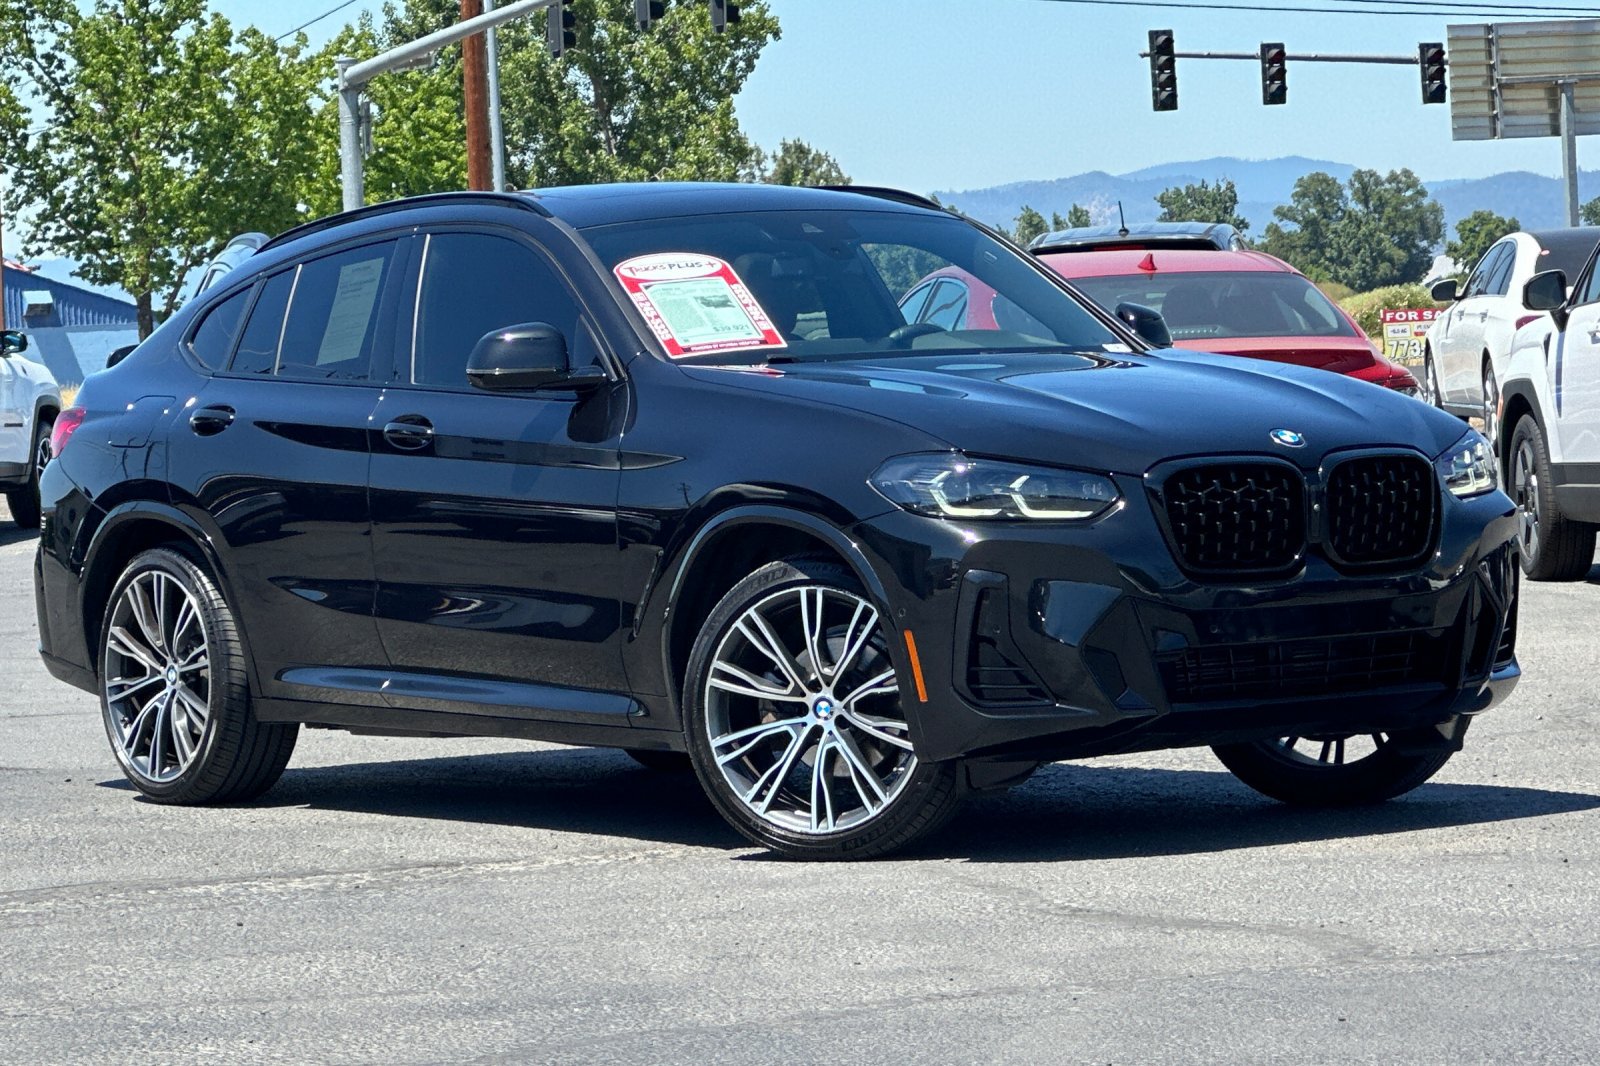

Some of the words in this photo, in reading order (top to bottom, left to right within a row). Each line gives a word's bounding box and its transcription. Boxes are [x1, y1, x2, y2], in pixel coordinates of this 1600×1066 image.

[668, 261, 704, 270] PLUS
[1385, 311, 1419, 321] FOR
[1422, 310, 1442, 320] SA
